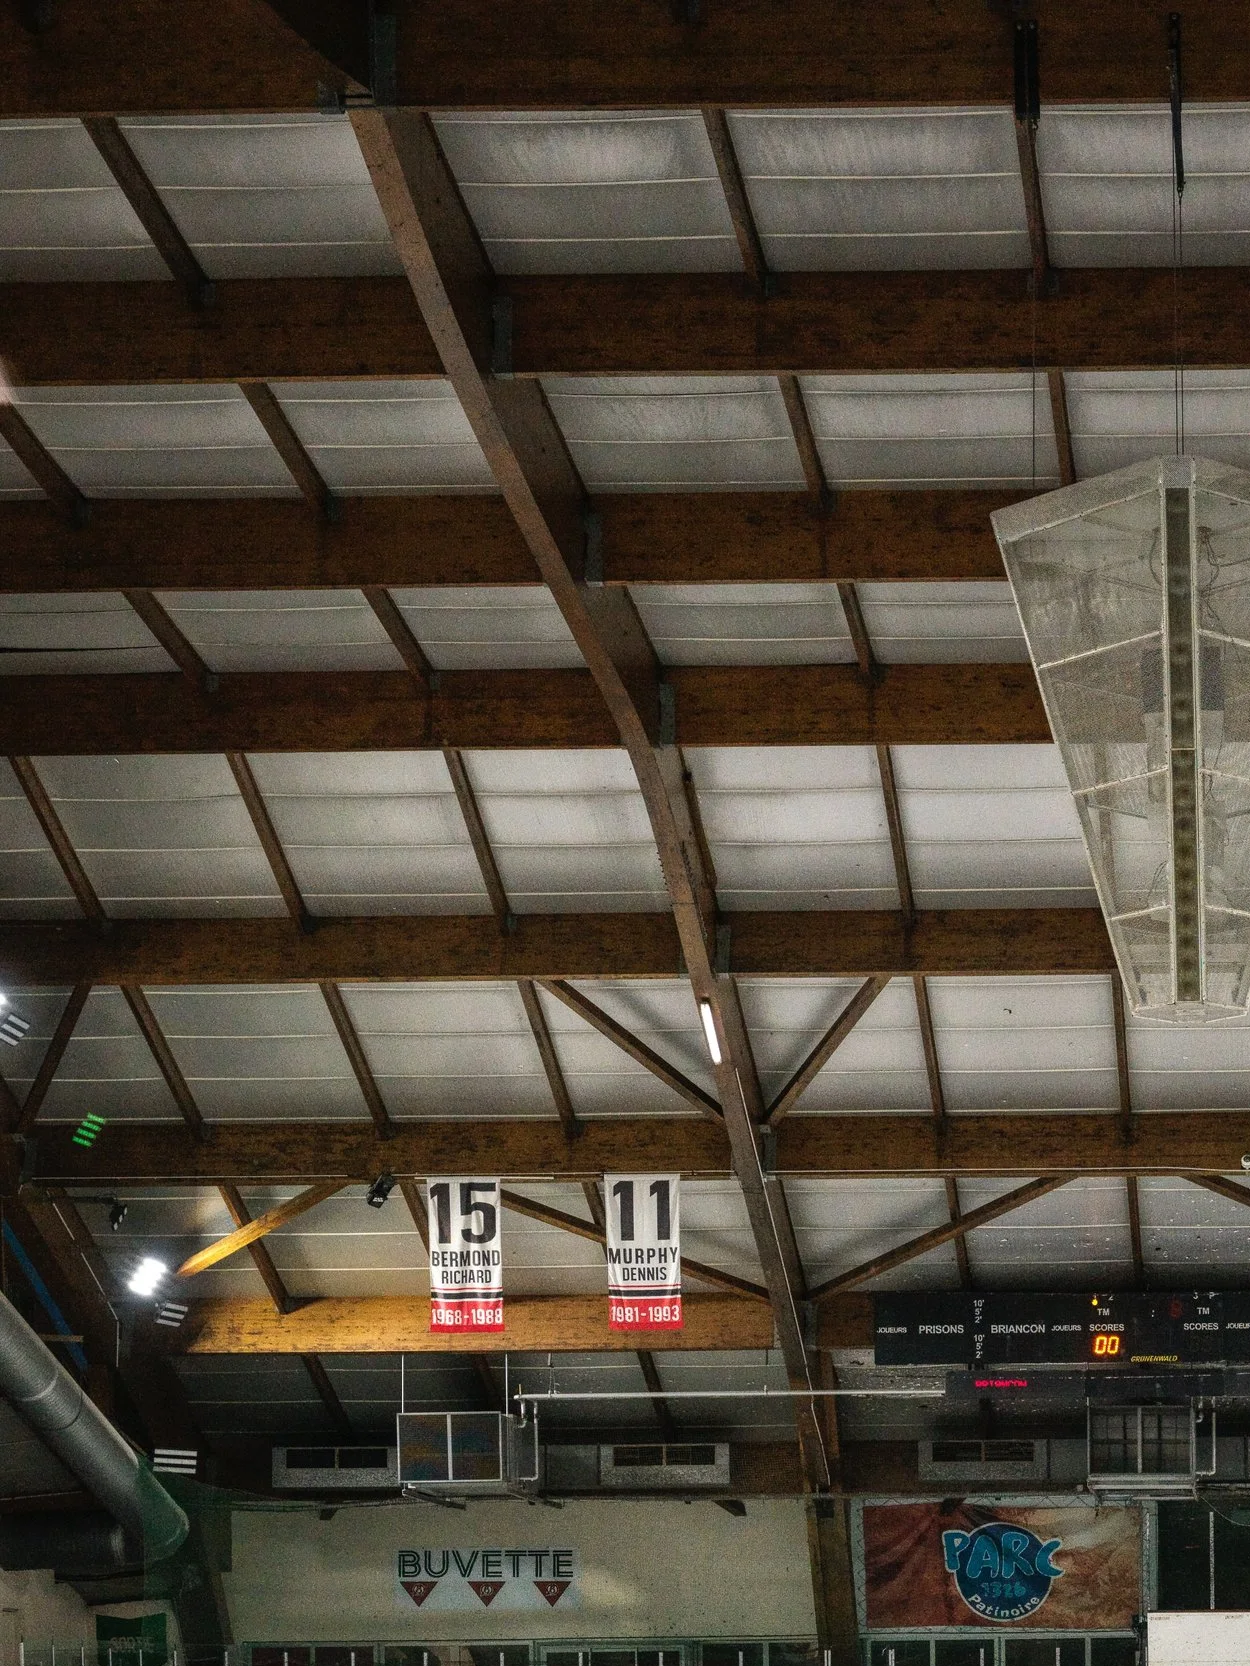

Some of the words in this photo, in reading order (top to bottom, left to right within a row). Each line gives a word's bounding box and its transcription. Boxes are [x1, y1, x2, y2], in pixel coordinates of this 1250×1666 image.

[430, 1182, 497, 1244] 15
[613, 1180, 671, 1241] 11
[432, 1250, 500, 1267] BERMOND
[608, 1247, 679, 1265] MURPHY
[441, 1270, 492, 1284] RICHARD
[622, 1267, 667, 1281] DENNIS
[432, 1308, 503, 1325] 1968-1988
[611, 1305, 680, 1323] 1981-1993
[1097, 1308, 1110, 1316] TM
[1197, 1307, 1210, 1315] TM
[918, 1325, 964, 1334] PRISONS
[990, 1324, 1046, 1334] BRIANCON
[1183, 1323, 1219, 1331] SCORES
[1094, 1336, 1120, 1354] 00
[942, 1529, 1066, 1579] PARC
[398, 1550, 573, 1578] BUVETTE
[968, 1593, 1040, 1618] Patinoire
